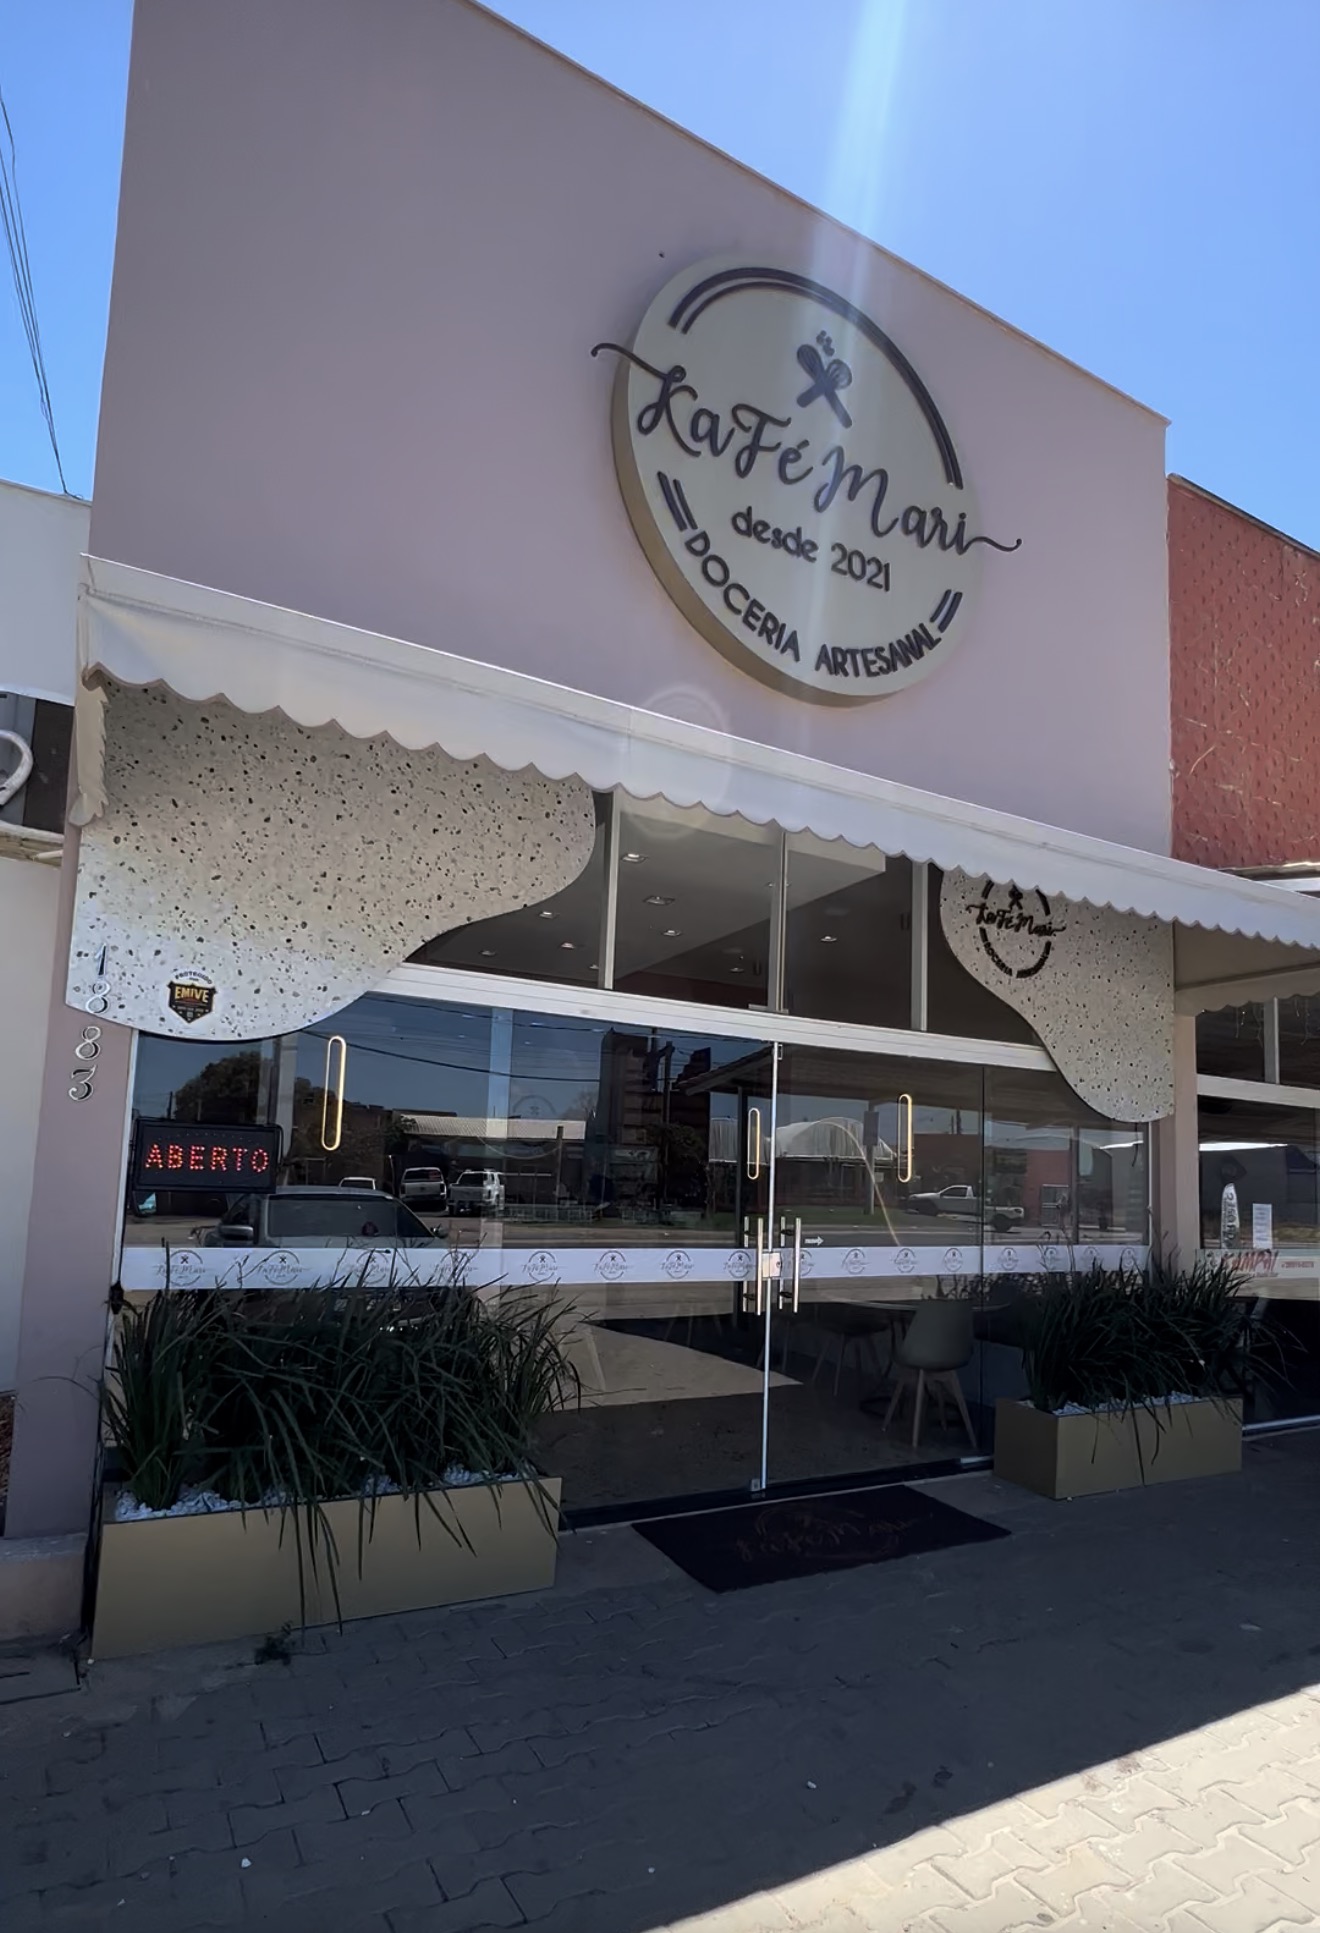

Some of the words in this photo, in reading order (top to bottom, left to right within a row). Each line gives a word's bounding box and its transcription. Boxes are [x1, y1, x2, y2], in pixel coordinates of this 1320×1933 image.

[731, 506, 819, 562] desde
[830, 543, 891, 592] 2021
[684, 529, 801, 663] DOCERIA
[814, 623, 942, 679] ARTESANAL
[174, 986, 209, 1003] EMIVE
[144, 1143, 270, 1174] ABERTO
